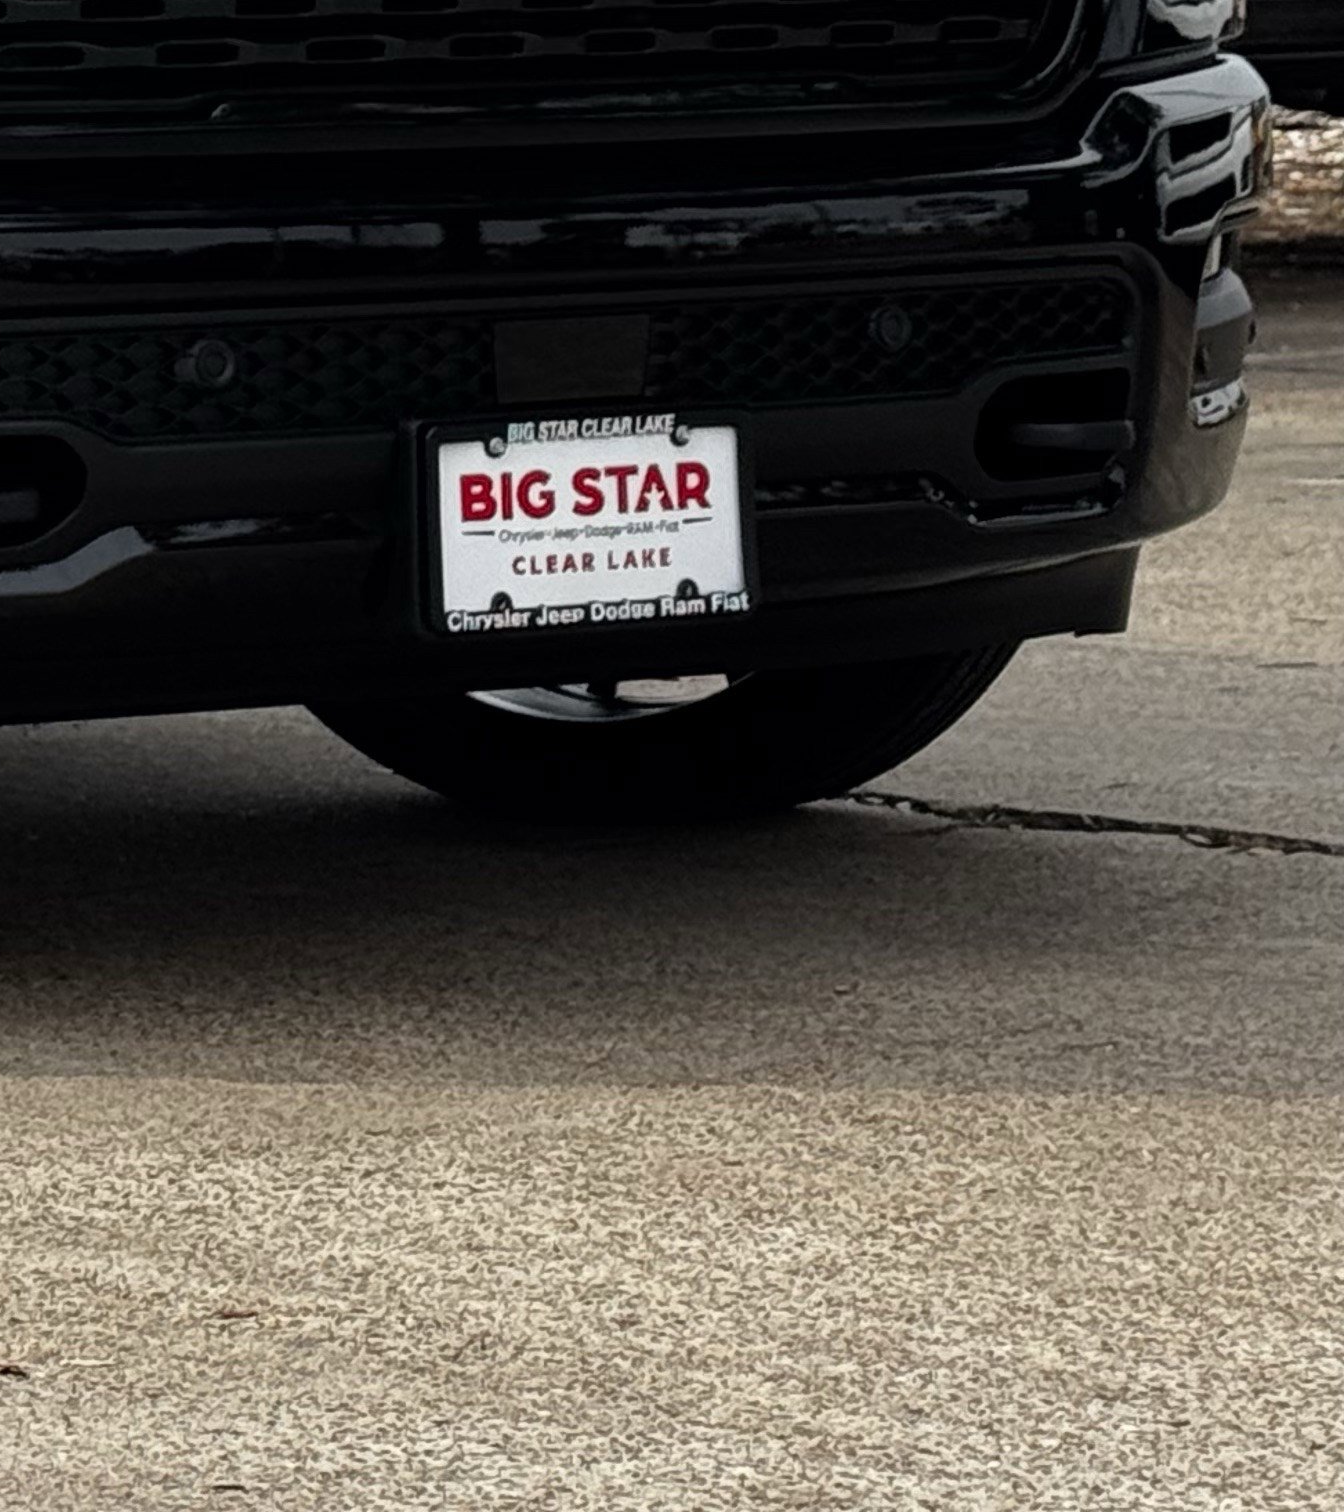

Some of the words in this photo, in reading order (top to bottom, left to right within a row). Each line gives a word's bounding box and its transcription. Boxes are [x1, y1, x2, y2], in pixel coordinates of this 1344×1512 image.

[507, 421, 535, 442] BIG
[538, 418, 579, 441] STAR
[581, 415, 632, 437] CLEAR
[635, 412, 676, 434] LAKE
[459, 470, 556, 522] BIG
[571, 461, 712, 516] STAR
[512, 552, 595, 576] CLEAR
[607, 546, 672, 570] LAKE
[447, 609, 531, 633] Chrysler
[535, 604, 584, 627] Jeep
[590, 598, 656, 623] Dodge
[661, 595, 706, 618] Ram
[711, 590, 750, 613] Fiat
